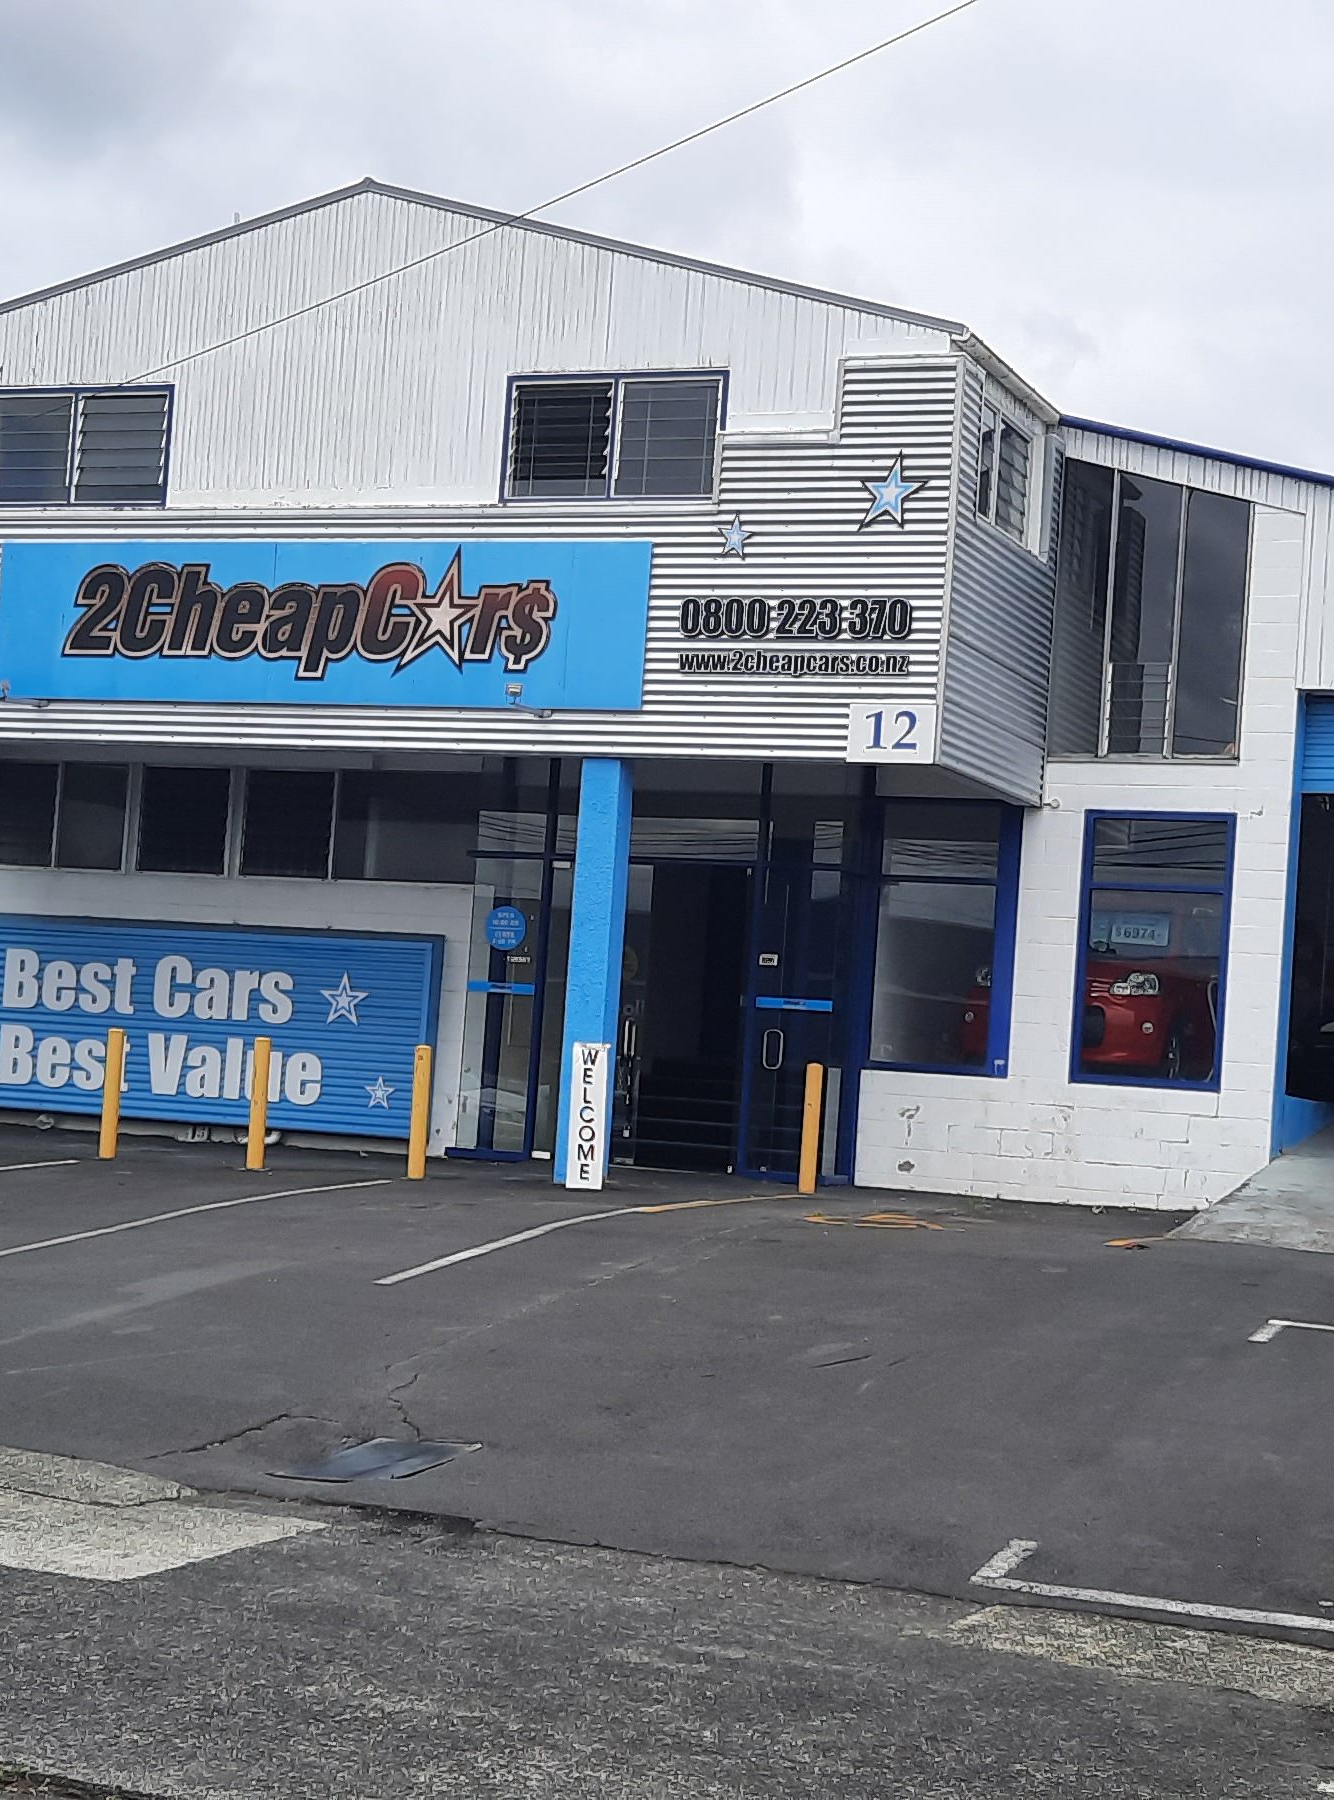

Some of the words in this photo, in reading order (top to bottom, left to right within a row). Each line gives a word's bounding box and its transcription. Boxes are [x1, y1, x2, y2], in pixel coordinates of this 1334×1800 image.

[679, 597, 770, 638] 0800
[773, 598, 843, 640] 223
[847, 598, 913, 640] 370
[678, 650, 911, 677] www.2cheapcars.co.nz
[866, 710, 917, 750] 12
[2, 948, 136, 1014] Best
[153, 955, 294, 1024] Cars
[147, 1032, 322, 1105] Value
[577, 1048, 599, 1181] WELCOME
